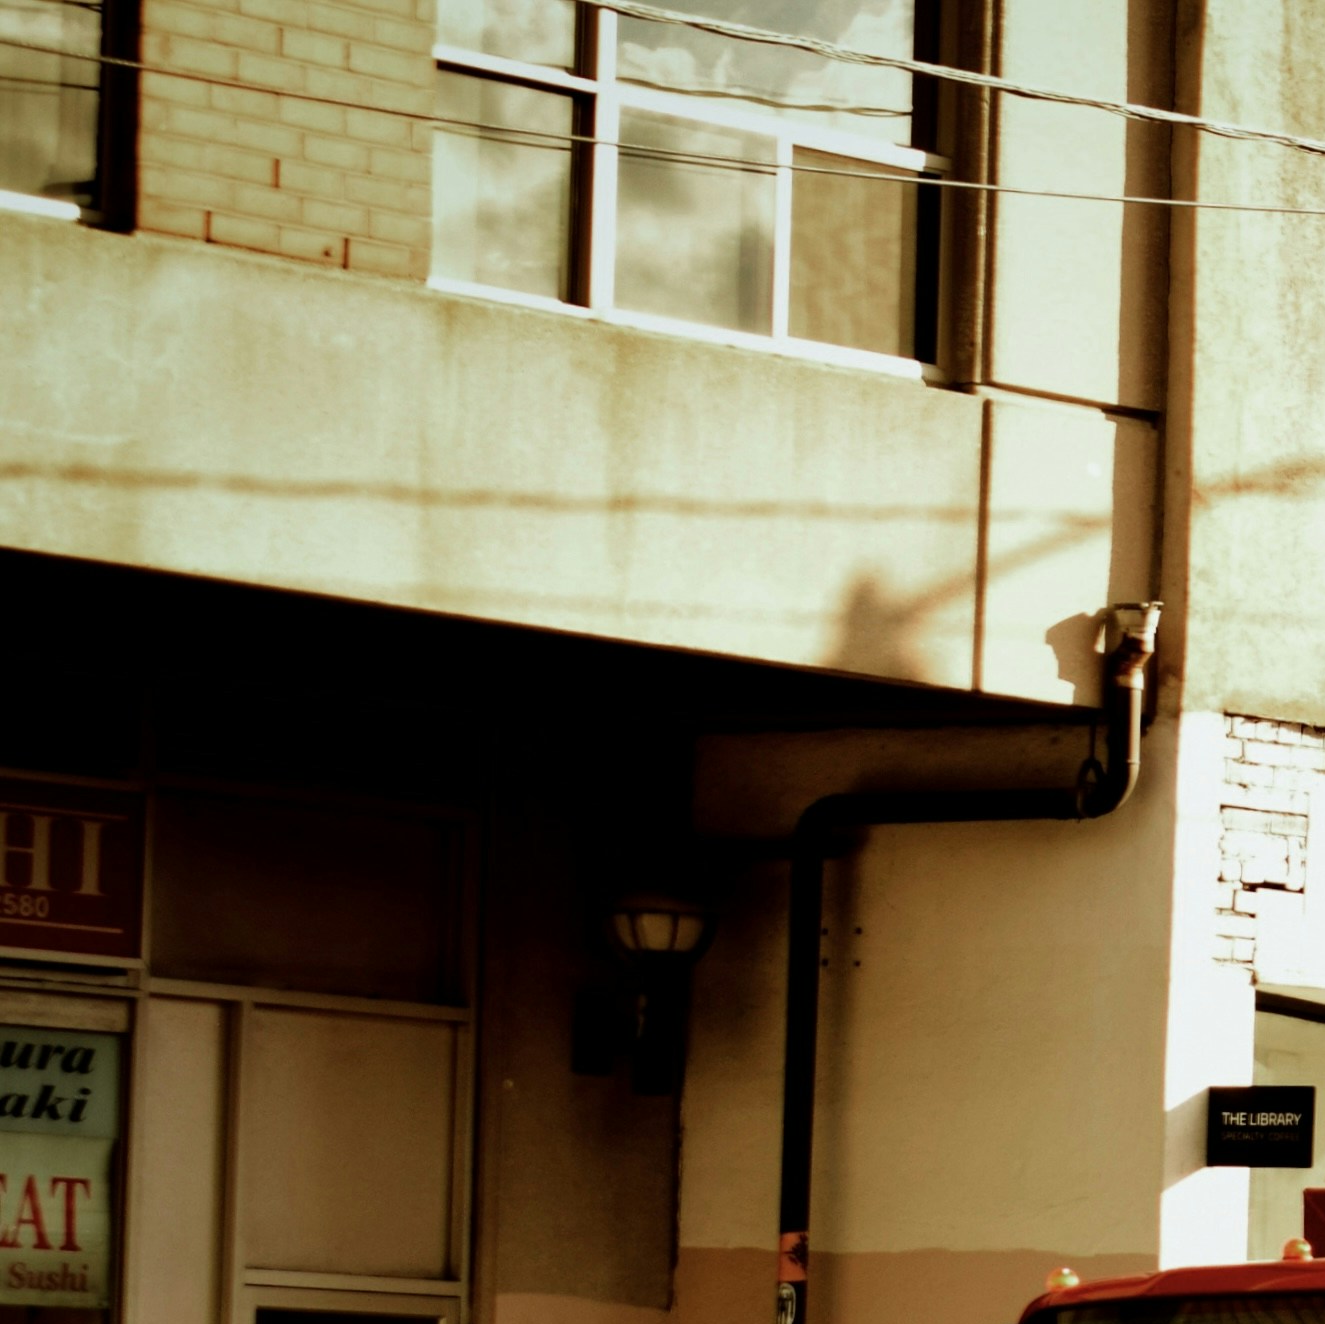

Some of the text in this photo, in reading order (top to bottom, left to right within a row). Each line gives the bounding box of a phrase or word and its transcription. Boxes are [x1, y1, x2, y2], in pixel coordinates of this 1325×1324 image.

[1221, 1111, 1303, 1127] THE LIBRARY
[8, 1262, 90, 1293] Sushi
